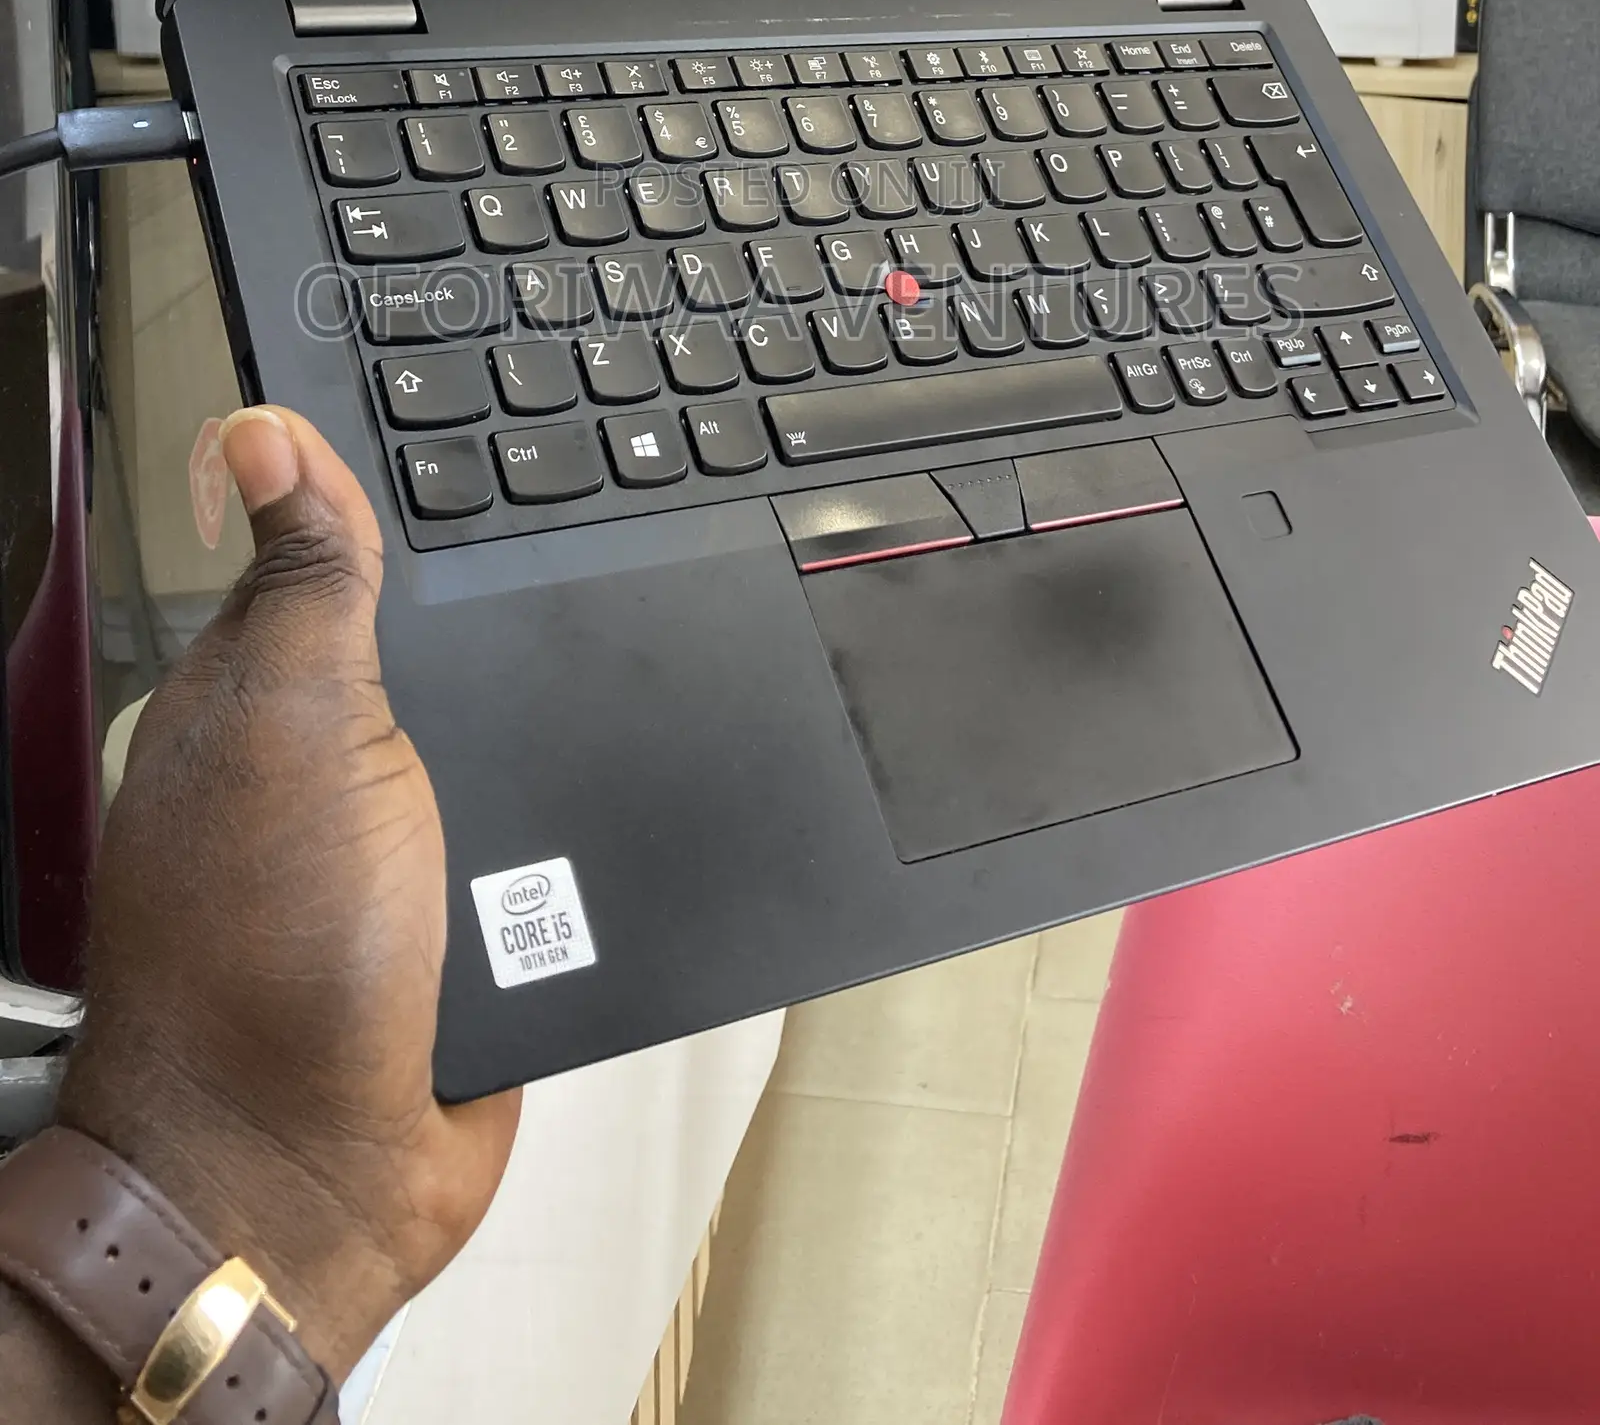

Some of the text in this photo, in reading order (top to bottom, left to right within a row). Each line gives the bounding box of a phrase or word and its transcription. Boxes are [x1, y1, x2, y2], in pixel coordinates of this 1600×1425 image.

[1120, 45, 1151, 56] Home
[1171, 44, 1191, 54] End
[1230, 41, 1262, 52] Delete
[980, 64, 997, 73] F10
[1030, 62, 1046, 71] F11
[1077, 60, 1094, 68] F12
[1176, 57, 1198, 65] Insert
[760, 73, 773, 83] F6
[815, 72, 828, 80] F7
[869, 69, 882, 78] F8
[932, 67, 944, 75] F9
[311, 78, 340, 91] Esc
[569, 83, 583, 93] F3
[630, 80, 645, 91] F4
[703, 76, 716, 85] F5
[440, 89, 452, 100] F1
[505, 85, 519, 95] F2
[1052, 89, 1059, 101] )
[1168, 84, 1179, 97] +
[316, 93, 358, 104] FnLock
[992, 92, 1001, 104] (
[1174, 101, 1188, 110] =
[727, 107, 739, 119] %
[864, 100, 876, 112] &
[1058, 103, 1069, 117] 0
[578, 115, 589, 127] £
[655, 110, 665, 124] $
[867, 113, 877, 128] 7
[933, 110, 946, 125] 8
[996, 107, 1008, 121] 9
[418, 123, 426, 138] !
[732, 120, 745, 136] 5
[801, 117, 814, 132] 6
[584, 130, 597, 146] 3
[659, 125, 672, 141] 4
[421, 139, 432, 155] 1
[503, 135, 517, 151] 2
[695, 137, 708, 149] €
[1050, 153, 1068, 172] O
[1107, 150, 1123, 168] P
[920, 163, 940, 182] U
[985, 159, 996, 176] I
[785, 172, 802, 191] T
[854, 167, 873, 186] Y
[638, 183, 657, 204] E
[712, 177, 735, 197] R
[479, 195, 503, 217] Q
[559, 188, 586, 210] W
[1211, 206, 1223, 219] @
[1093, 218, 1110, 237] L
[1264, 216, 1274, 228] #
[970, 229, 982, 248] J
[1030, 223, 1050, 242] K
[831, 241, 852, 261] G
[900, 234, 920, 253] H
[682, 254, 703, 275] D
[757, 247, 773, 267] F
[604, 262, 625, 282] S
[526, 270, 545, 291] A
[1213, 274, 1225, 289] ?
[369, 287, 455, 308] CapsLock
[1027, 294, 1050, 315] M
[961, 301, 982, 322] N
[821, 317, 838, 338] V
[896, 320, 915, 340] B
[1385, 324, 1411, 339] PgDn
[748, 325, 768, 346] C
[669, 334, 692, 356] X
[1276, 338, 1305, 353] PgUp
[588, 343, 610, 365] Z
[1230, 351, 1253, 364] Ctrl
[1126, 363, 1158, 377] AltGr
[1178, 357, 1212, 371] PrtSc
[699, 420, 720, 435] Alt
[507, 446, 538, 463] Ctrl
[415, 460, 439, 476] Fn
[1491, 556, 1573, 695] ThinkPad
[506, 881, 546, 906] intel
[501, 911, 573, 955] CORE i5
[519, 945, 569, 972] 10TH GEN
